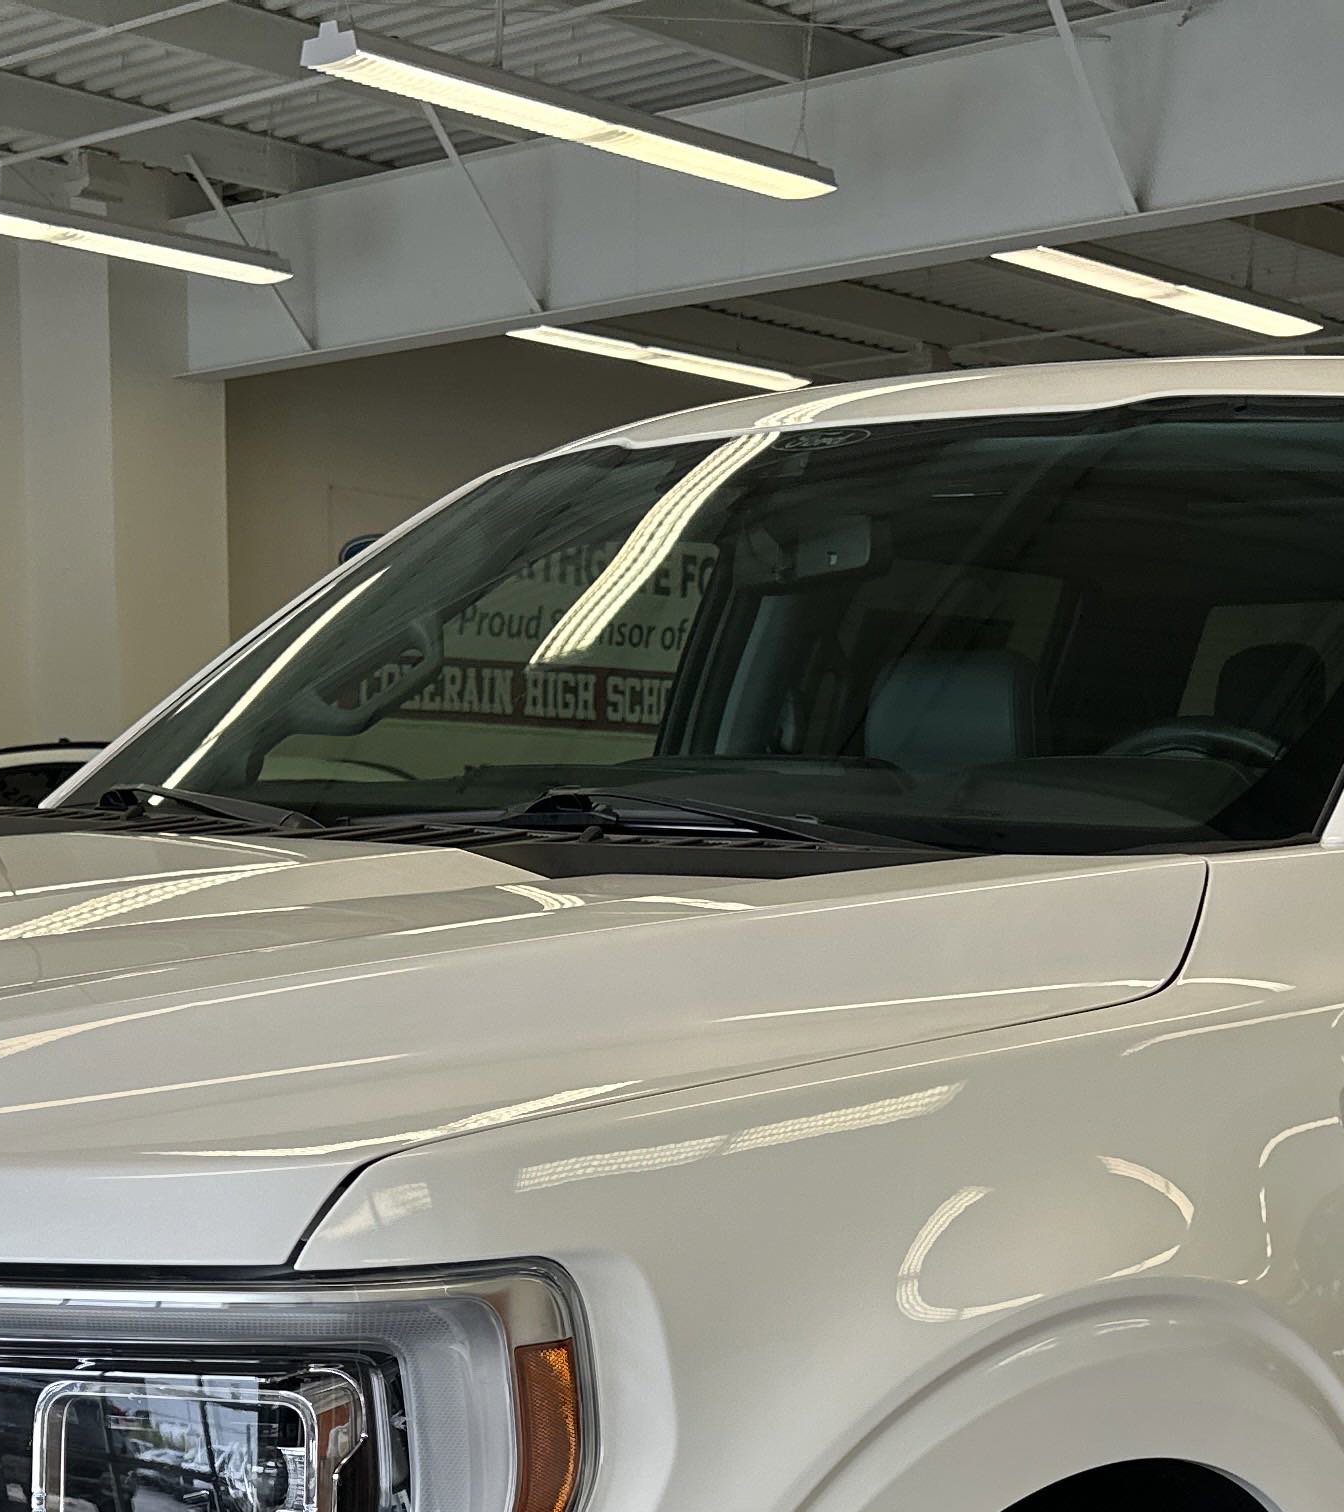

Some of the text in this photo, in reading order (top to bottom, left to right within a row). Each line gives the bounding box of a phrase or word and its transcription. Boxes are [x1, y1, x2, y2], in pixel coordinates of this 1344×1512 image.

[457, 604, 544, 641] Proud
[660, 618, 690, 651] of
[524, 670, 597, 721] HIGH
